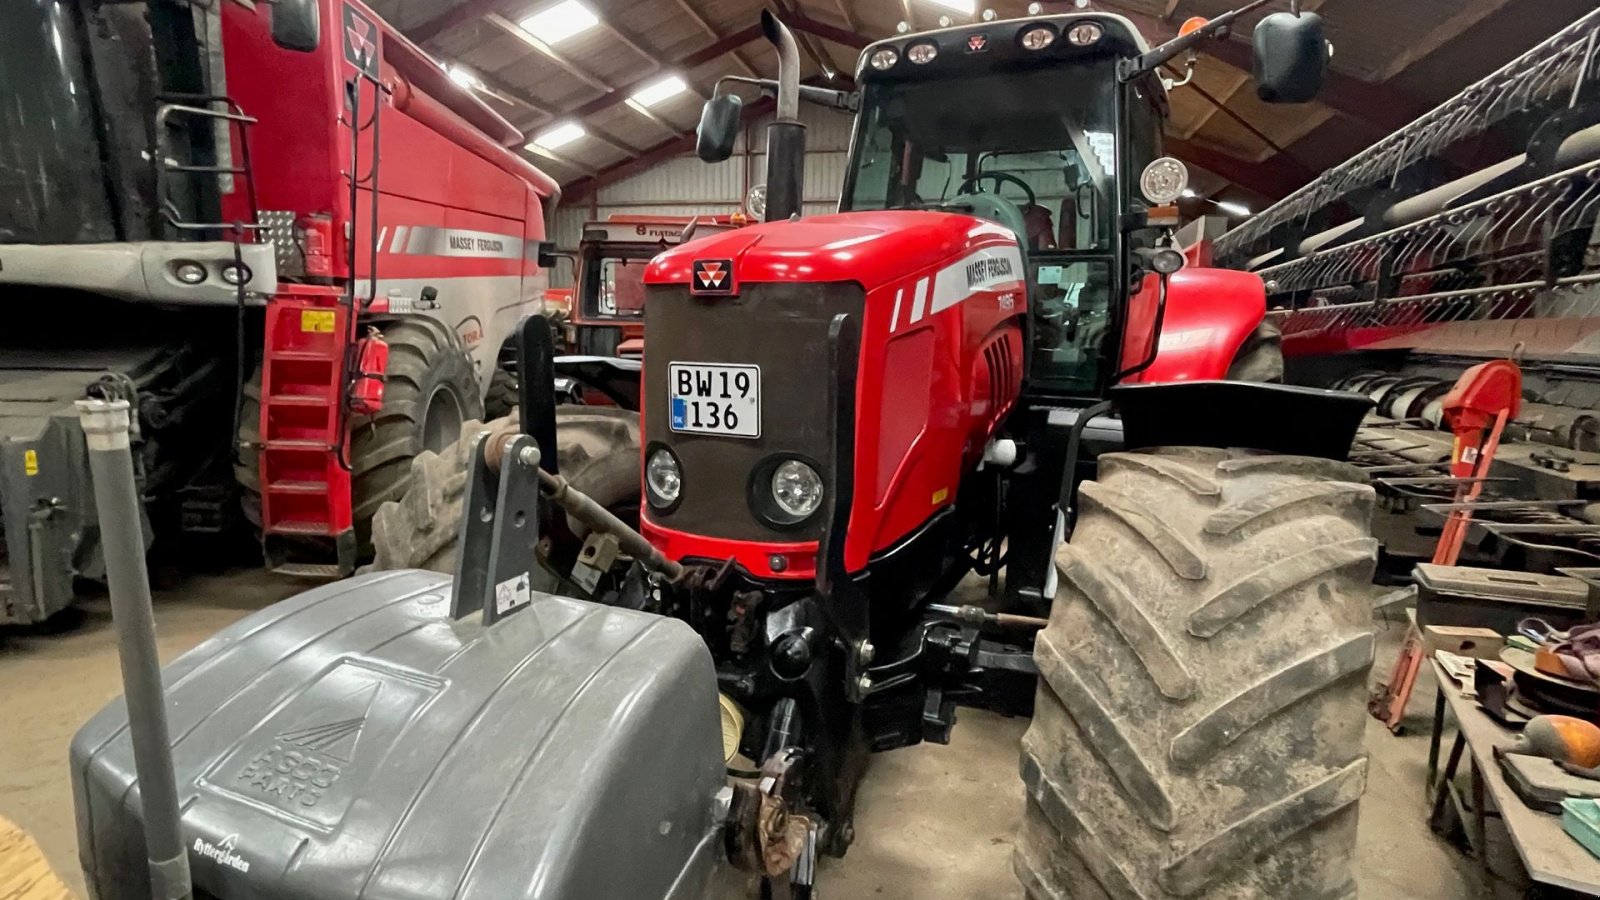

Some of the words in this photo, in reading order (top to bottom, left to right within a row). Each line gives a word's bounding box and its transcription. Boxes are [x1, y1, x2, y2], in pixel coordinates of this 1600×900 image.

[449, 235, 475, 251] MASSEY
[477, 238, 504, 253] FERGUSON
[966, 260, 988, 288] MASSEY
[987, 257, 1013, 280] FERGUSON
[691, 401, 739, 430] 136
[251, 744, 341, 789] AGCO
[238, 764, 322, 807] PARTS
